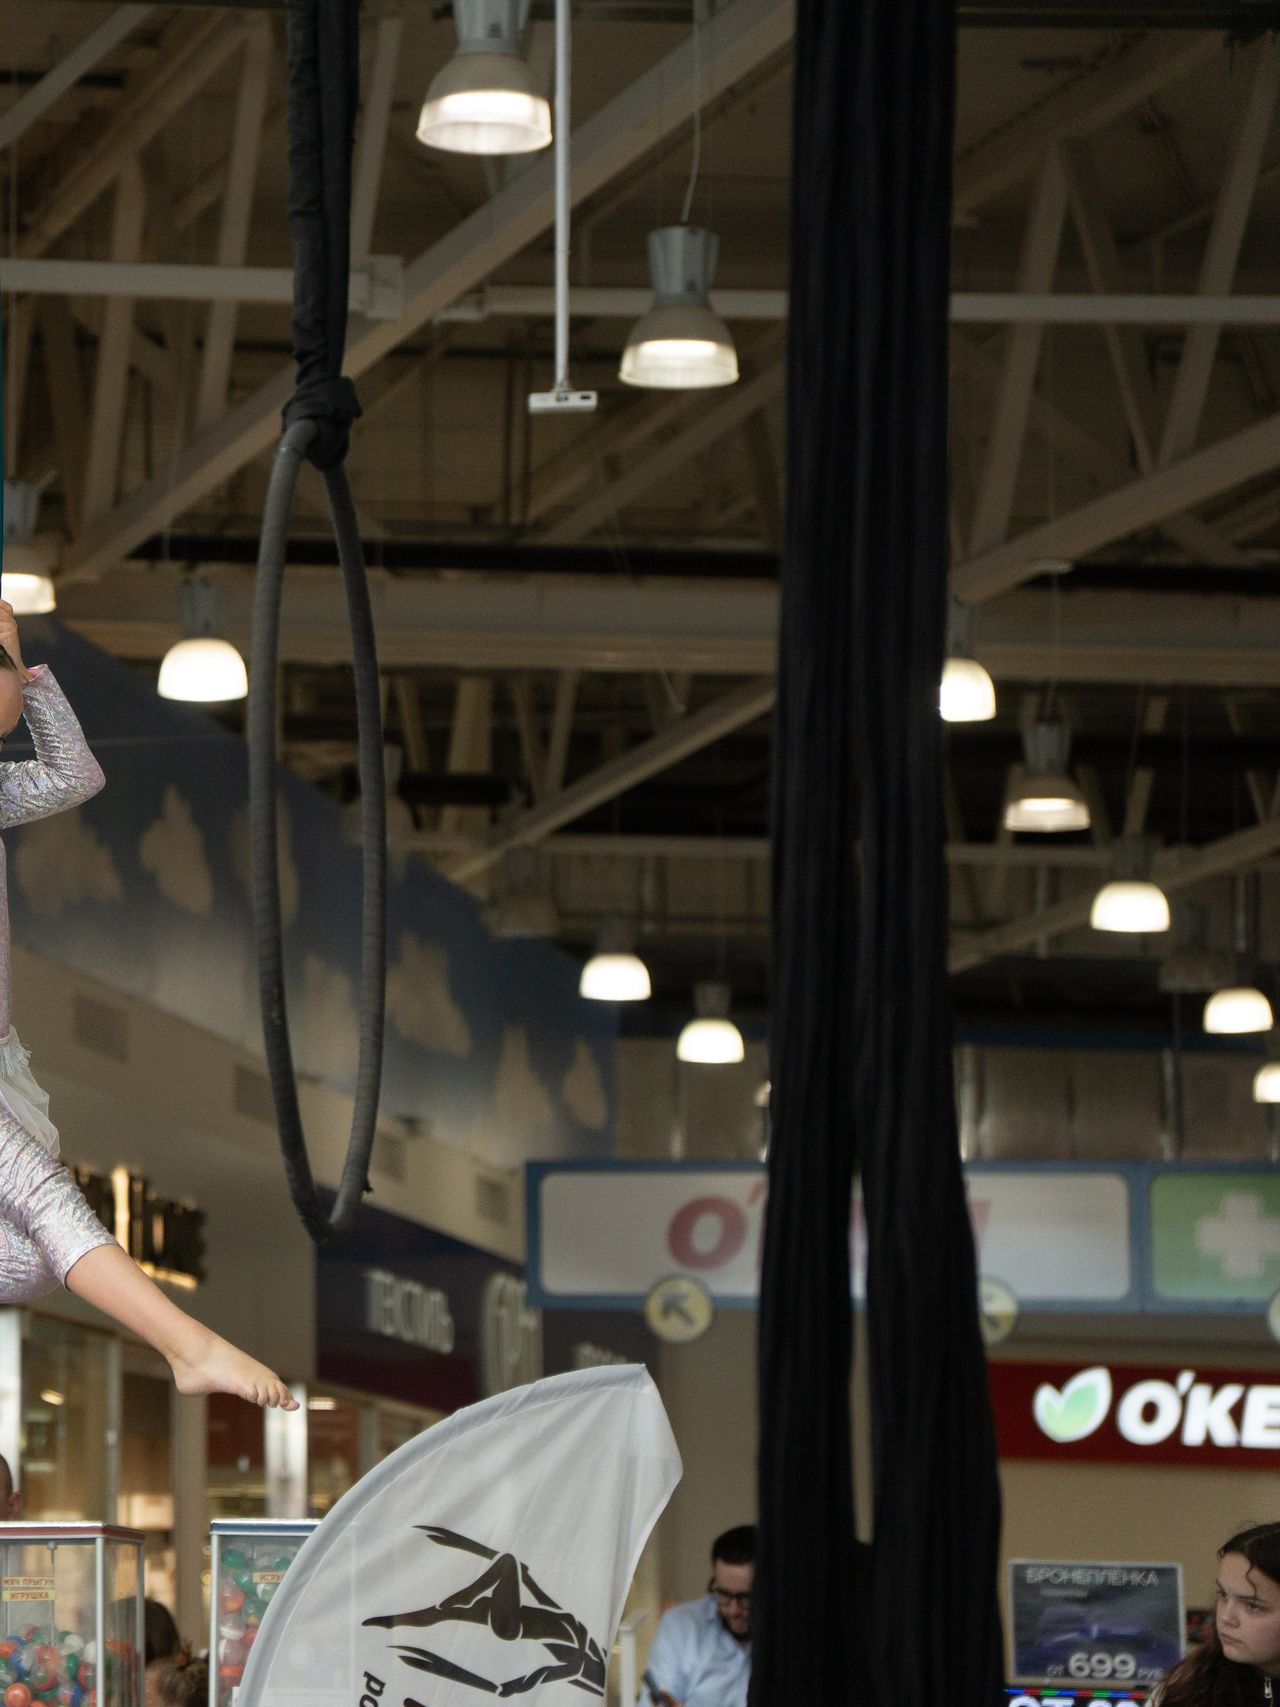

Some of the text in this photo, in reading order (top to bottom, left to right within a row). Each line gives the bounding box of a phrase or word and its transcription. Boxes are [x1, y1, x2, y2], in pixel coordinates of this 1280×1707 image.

[3, 1578, 55, 1586] МЯЧ ПРЫГУН
[10, 1592, 50, 1600] ИГРУШКА
[1068, 1652, 1137, 1680] 699
